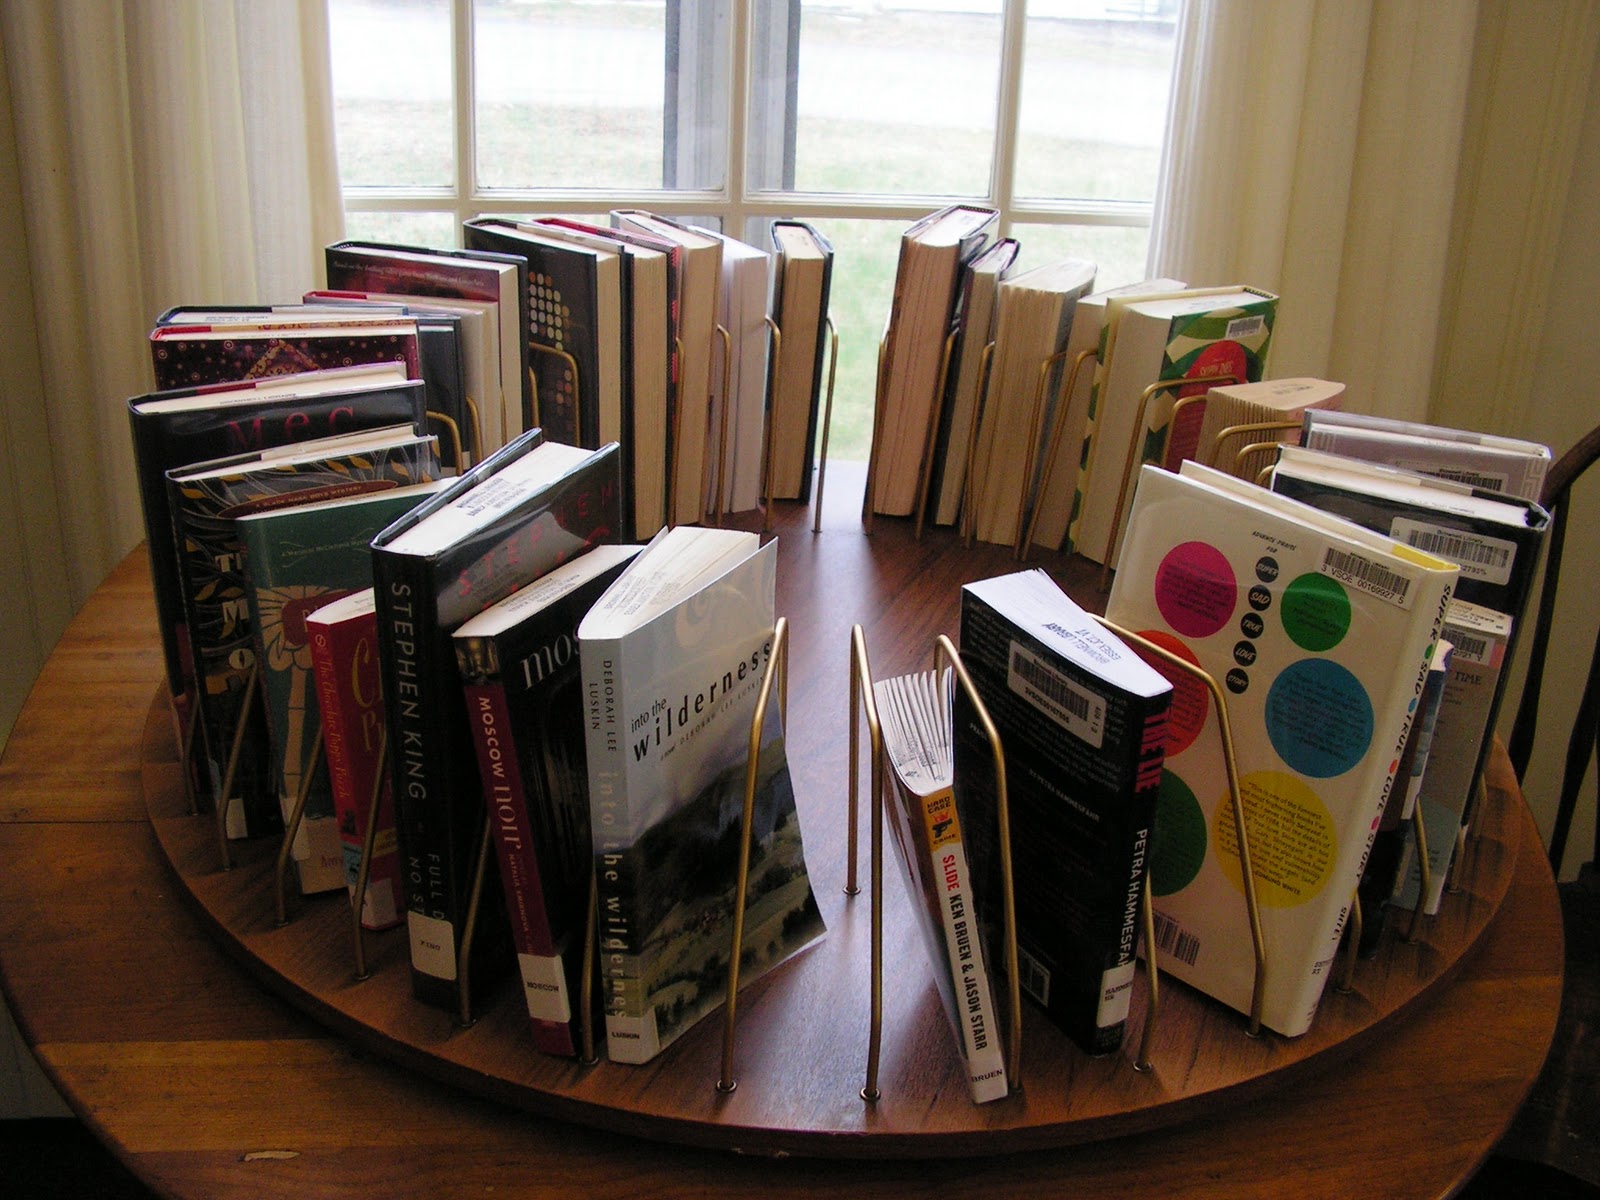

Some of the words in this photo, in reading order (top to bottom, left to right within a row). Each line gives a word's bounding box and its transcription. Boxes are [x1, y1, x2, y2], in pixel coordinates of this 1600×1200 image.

[332, 485, 362, 496] MYSTERY
[459, 479, 615, 597] STEPHEN
[1256, 562, 1279, 577] SUPER
[1321, 564, 1328, 572] 3
[1250, 591, 1270, 605] SAD
[1430, 583, 1452, 641] SUPER
[1242, 617, 1262, 633] TRUE
[392, 582, 421, 722] STEPHEN
[1237, 646, 1257, 661] LOVE
[603, 660, 615, 725] DEBORAH
[1228, 673, 1248, 687] STORY
[1415, 661, 1429, 696] SAD
[589, 683, 601, 731] LUSKIN
[631, 711, 650, 734] into
[651, 698, 667, 717] the
[632, 641, 772, 763] wilderness
[679, 712, 717, 745] DEBORAH
[721, 699, 734, 713] LEE
[1140, 708, 1170, 758] THE
[1395, 714, 1413, 756] TRUE
[607, 732, 617, 754] LEE
[402, 731, 428, 802] KING
[478, 695, 504, 779] MOSCOW
[493, 786, 521, 850] noir
[1134, 757, 1164, 794] LIE
[600, 770, 619, 826] into
[926, 796, 951, 809] HARD
[927, 801, 952, 815] CASE
[1376, 776, 1393, 816] LOVE
[933, 833, 956, 845] CRIME
[1129, 828, 1149, 887] PETRA
[1356, 832, 1375, 881] STORY
[409, 856, 422, 884] NO
[427, 853, 443, 899] FULL
[603, 842, 624, 882] the
[942, 854, 960, 892] SLIDE
[949, 893, 964, 920] KEN
[954, 921, 973, 962] BRUEN
[527, 981, 560, 993] MOSCOW
[961, 963, 974, 975] &
[964, 976, 982, 1014] JASON
[611, 1031, 641, 1041] LUSKIN
[970, 1015, 988, 1052] STARR
[971, 1068, 1003, 1083] BRUEN
